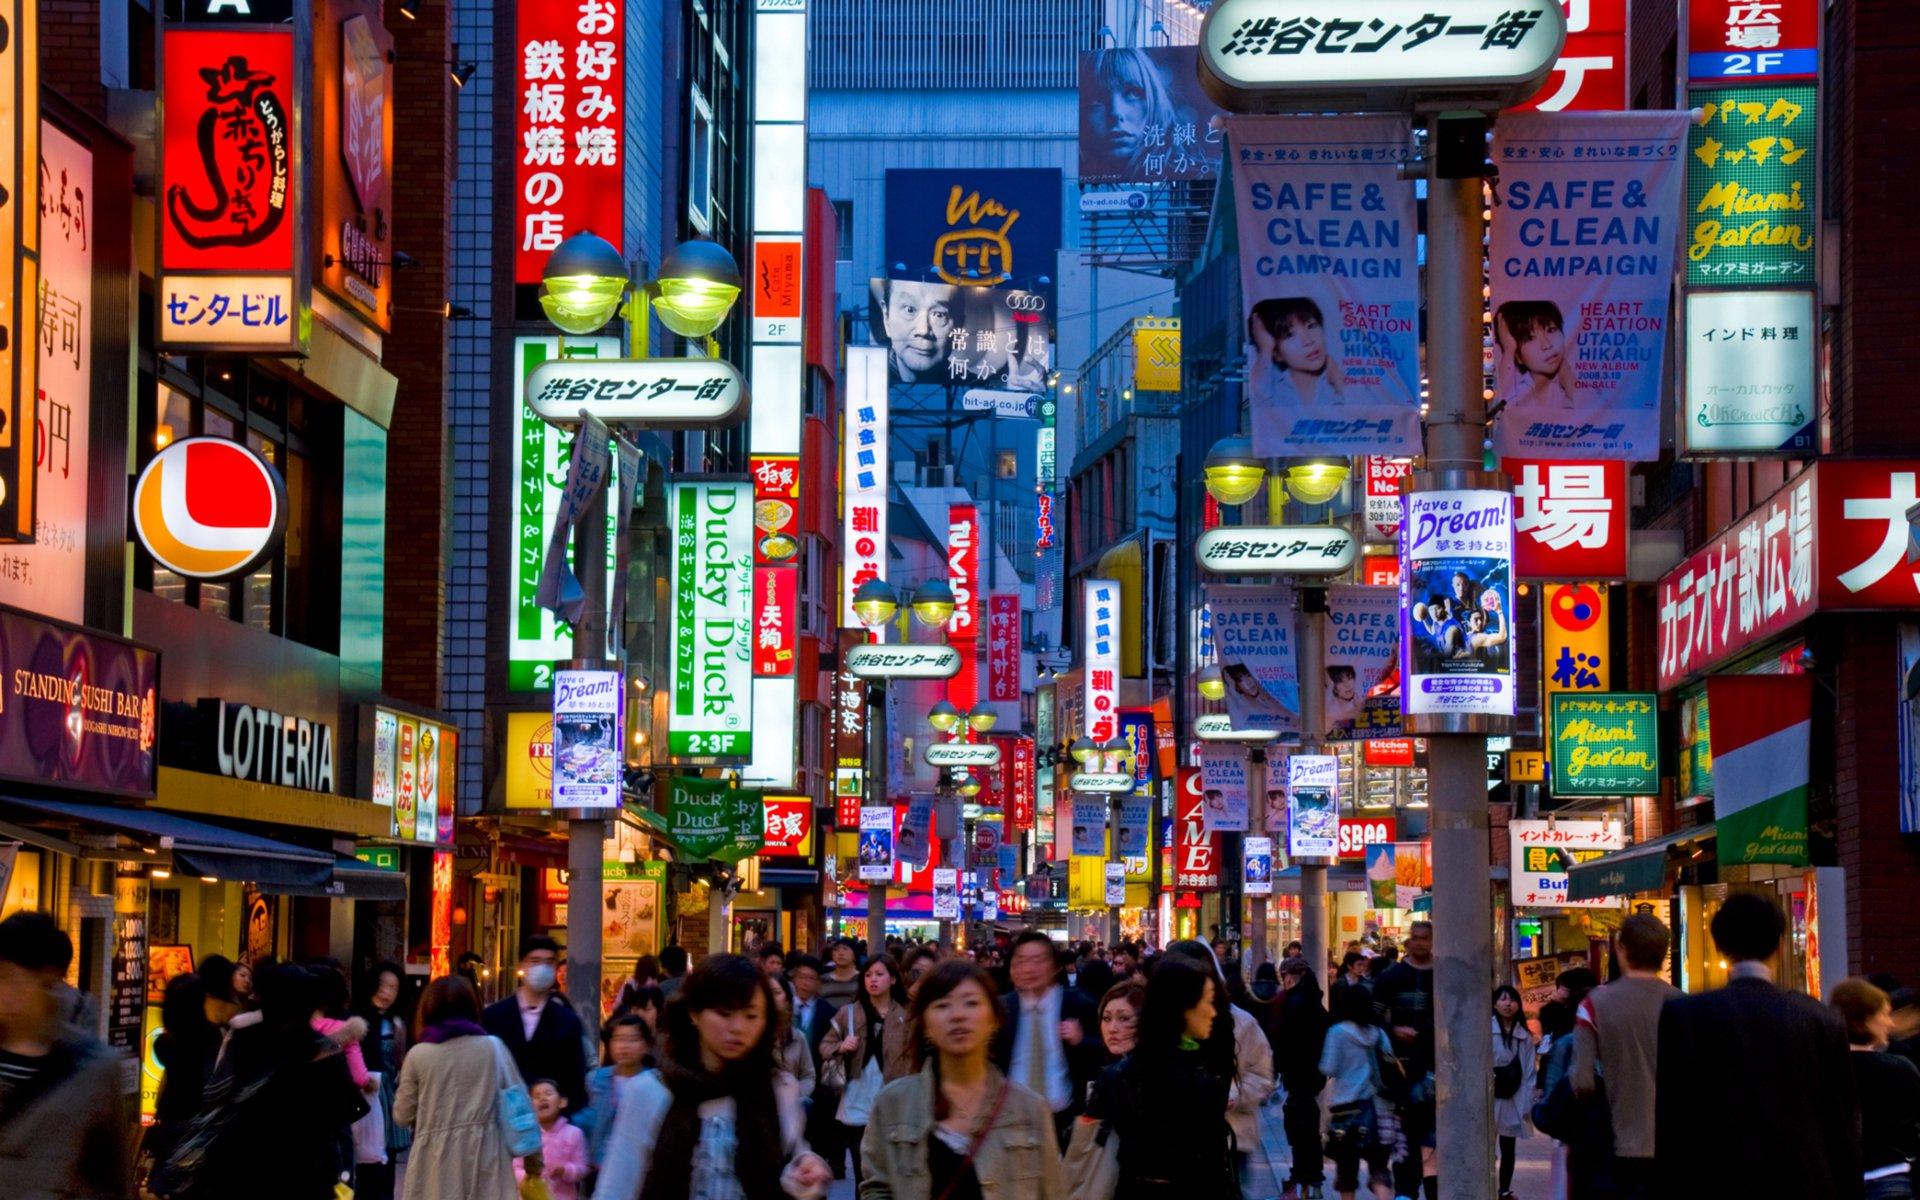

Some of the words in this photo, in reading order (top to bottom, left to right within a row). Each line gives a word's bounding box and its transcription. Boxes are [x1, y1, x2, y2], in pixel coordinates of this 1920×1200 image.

[1220, 10, 1544, 57] 渋谷センター街
[1724, 0, 1782, 49] 広場
[1722, 53, 1785, 75] 2F
[575, 0, 616, 166] お好み焼
[1698, 97, 1802, 128] パスタ
[1143, 121, 1221, 148] 洗練と
[523, 40, 566, 252] 鉄板焼の店
[1241, 148, 1300, 161] 安全・安心
[1308, 146, 1411, 161] きれいな街づくり
[1503, 146, 1565, 159] 安全・安心
[1573, 144, 1678, 158] きれいな街づくり
[1695, 136, 1808, 168] キッチン
[1142, 153, 1210, 177] 何か。
[1251, 182, 1353, 211] SAFE
[1360, 182, 1386, 211] &
[1507, 180, 1615, 210] SAFE
[1622, 179, 1648, 208] &
[1696, 181, 1805, 217] Miami
[1267, 217, 1400, 248] CLEAN
[1519, 216, 1660, 247] CLEAN
[1256, 254, 1401, 279] CAMPAIGN
[1504, 255, 1658, 278] CAMPAIGN
[1698, 261, 1805, 275] マイアミガーデン
[782, 253, 793, 307] Miyama
[167, 292, 289, 327] センタービル
[1338, 301, 1392, 318] HEART
[1580, 302, 1644, 317] HEART
[768, 324, 786, 336] 2F
[1582, 317, 1663, 332] STATION
[1702, 326, 1800, 342] インド料理
[948, 328, 1047, 355] 常識とは
[1577, 332, 1639, 347] UTADA
[1579, 347, 1651, 361] HIKARU
[947, 356, 1009, 383] 何か。
[1575, 362, 1599, 370] NEW
[1601, 362, 1639, 371] ALBUM
[538, 377, 734, 401] 渋谷センター街
[1573, 381, 1617, 390] ON-SALE
[1706, 383, 1796, 396] オー・カルカッタ
[964, 396, 1025, 411] hit-ad.co.jp
[1525, 422, 1626, 440] 渋谷センター街
[1794, 435, 1810, 447] B1
[857, 406, 877, 489] 現金問屋
[756, 460, 794, 488] すき家
[1371, 464, 1408, 479] BOX
[1412, 498, 1449, 514] Have
[1452, 499, 1463, 510] a
[1515, 464, 1613, 551] 場
[1412, 497, 1508, 551] Dream!
[696, 487, 737, 607] Ducky
[1205, 538, 1350, 560] 渋谷センター街
[1435, 539, 1508, 551] 夢を持とう!
[1661, 478, 1813, 678] カラオケ歌広場
[759, 605, 782, 649] 天狗
[1216, 611, 1265, 626] SAFE
[1267, 611, 1279, 625] &
[1332, 611, 1381, 626] SAFE
[1384, 613, 1396, 628] &
[1224, 628, 1287, 642] CLEAN
[1338, 628, 1400, 644] CLEAN
[703, 618, 737, 718] Duck
[763, 662, 776, 673] B1
[852, 652, 955, 667] 渋谷センター街
[1255, 666, 1285, 674] HEART
[1551, 647, 1601, 689] 松
[14, 668, 82, 706] STANDING
[81, 684, 114, 714] SUSHI
[117, 691, 140, 719] BAR
[557, 675, 615, 707] Dream!
[1559, 718, 1637, 744] Miami
[217, 699, 334, 794] LOTTERIA
[929, 749, 998, 760] 渋谷センター街
[1137, 724, 1149, 780] GAME
[1370, 741, 1408, 750] Kitchen
[1204, 760, 1231, 768] SAFE
[1208, 769, 1245, 778] CLEAN
[1292, 760, 1336, 782] Dream!
[1516, 759, 1539, 775] 1F
[1569, 777, 1646, 787] マイアミガーデン
[1760, 824, 1810, 843] Miami
